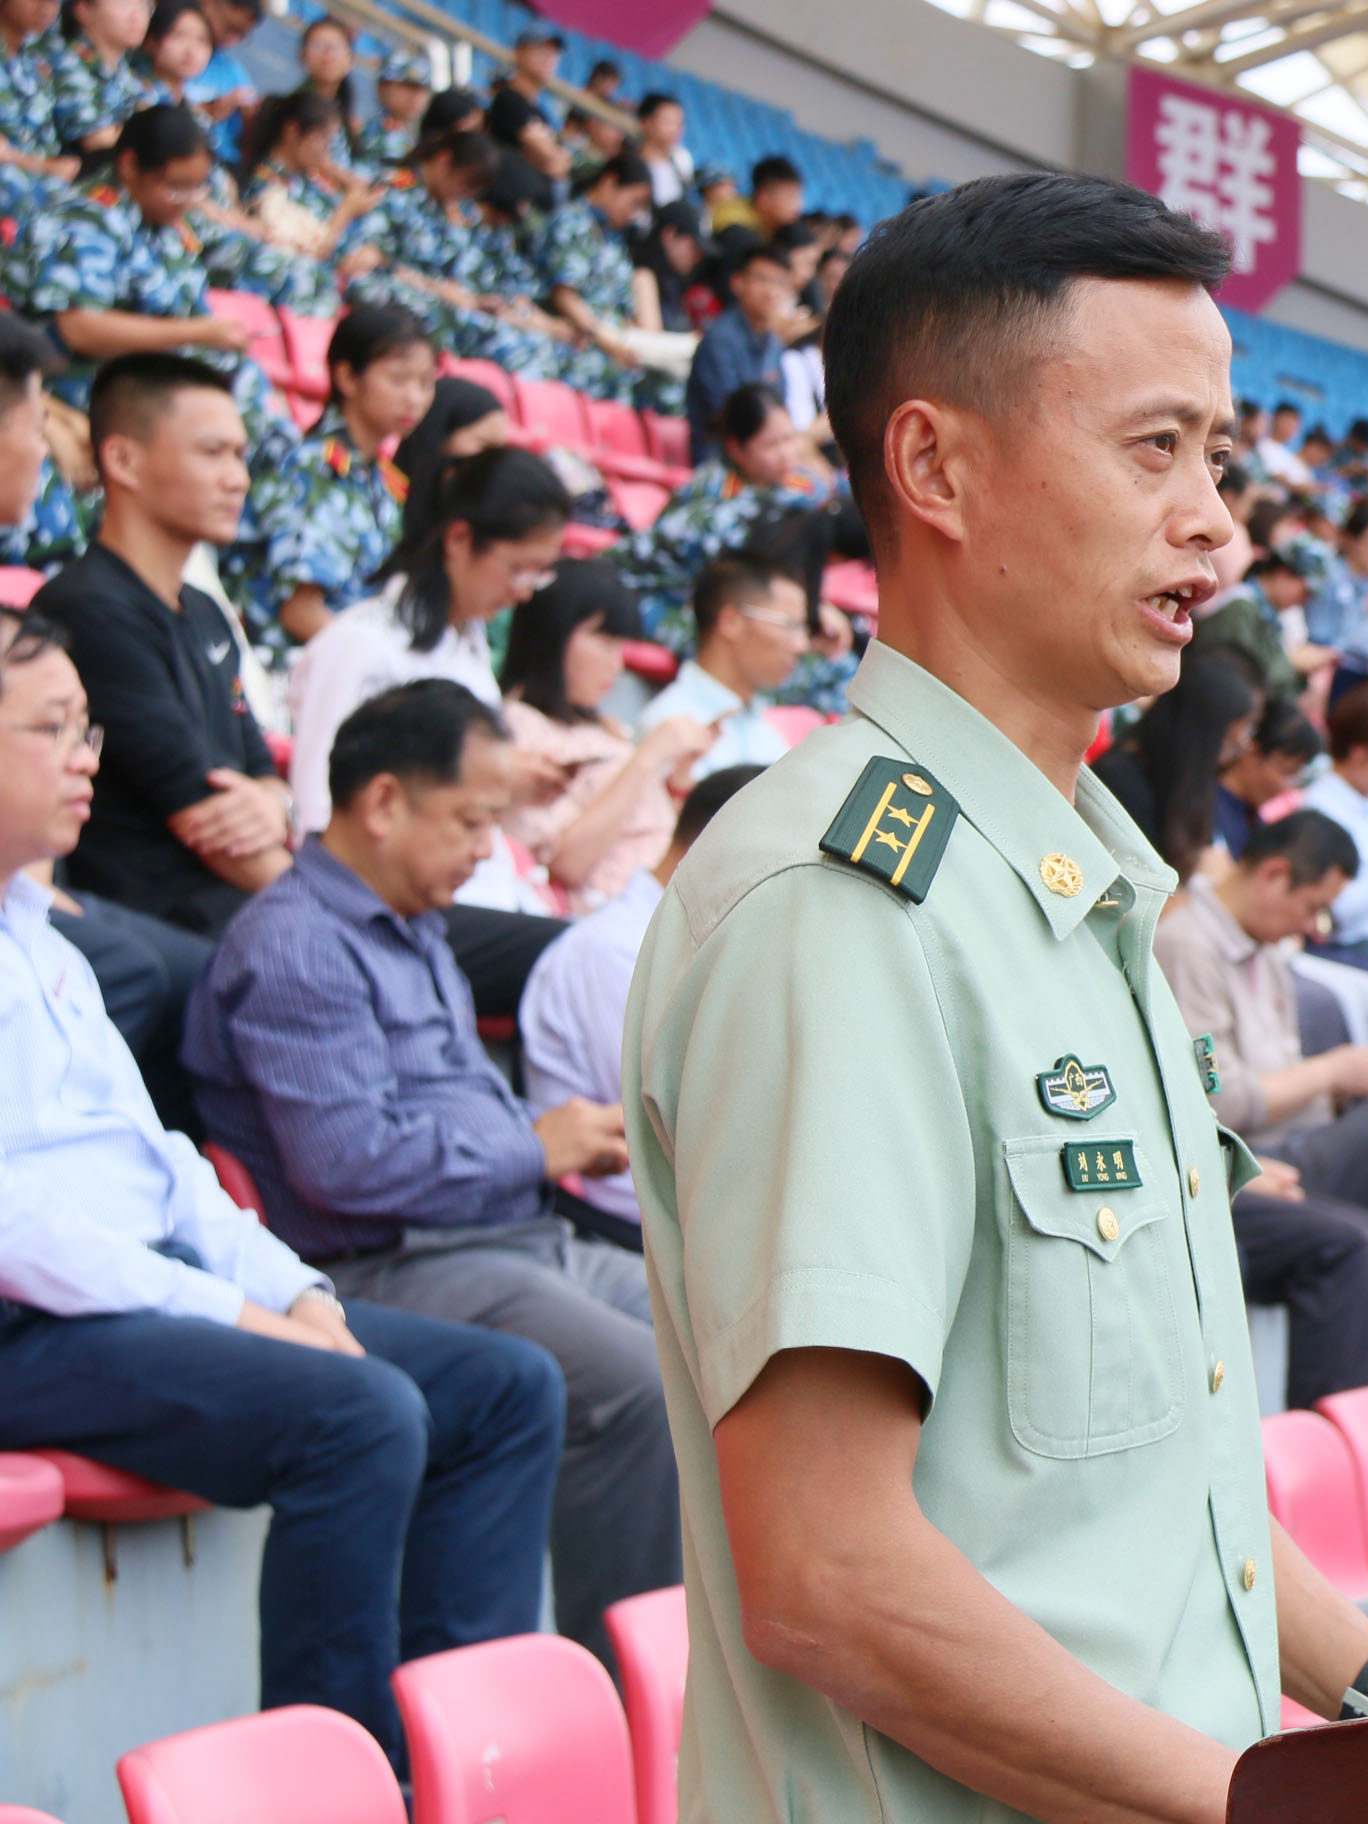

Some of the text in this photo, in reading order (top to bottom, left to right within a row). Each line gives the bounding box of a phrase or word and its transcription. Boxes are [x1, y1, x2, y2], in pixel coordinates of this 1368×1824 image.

[1155, 94, 1276, 274] 群
[1068, 1072, 1084, 1087] 广西
[1077, 1150, 1125, 1172] 刘永明
